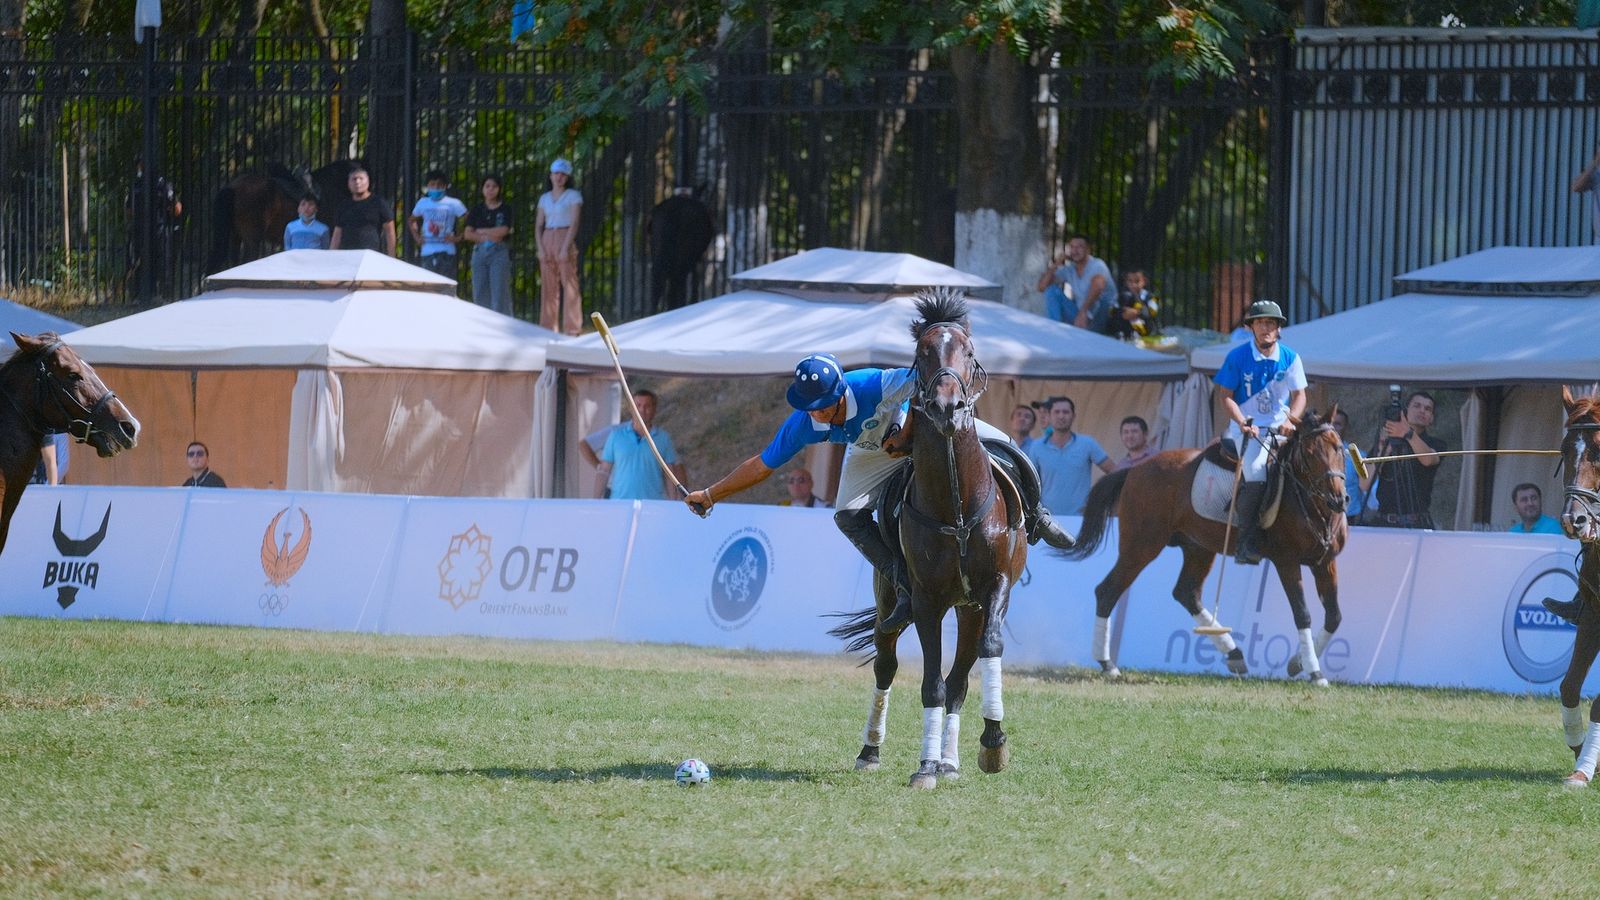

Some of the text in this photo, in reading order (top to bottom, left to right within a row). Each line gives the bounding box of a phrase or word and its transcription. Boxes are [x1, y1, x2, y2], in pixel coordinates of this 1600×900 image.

[1245, 382, 1252, 397] 1
[43, 561, 99, 589] BUKA
[500, 546, 579, 592] OFB
[1518, 610, 1577, 627] VOLV
[1164, 622, 1350, 673] netoe
